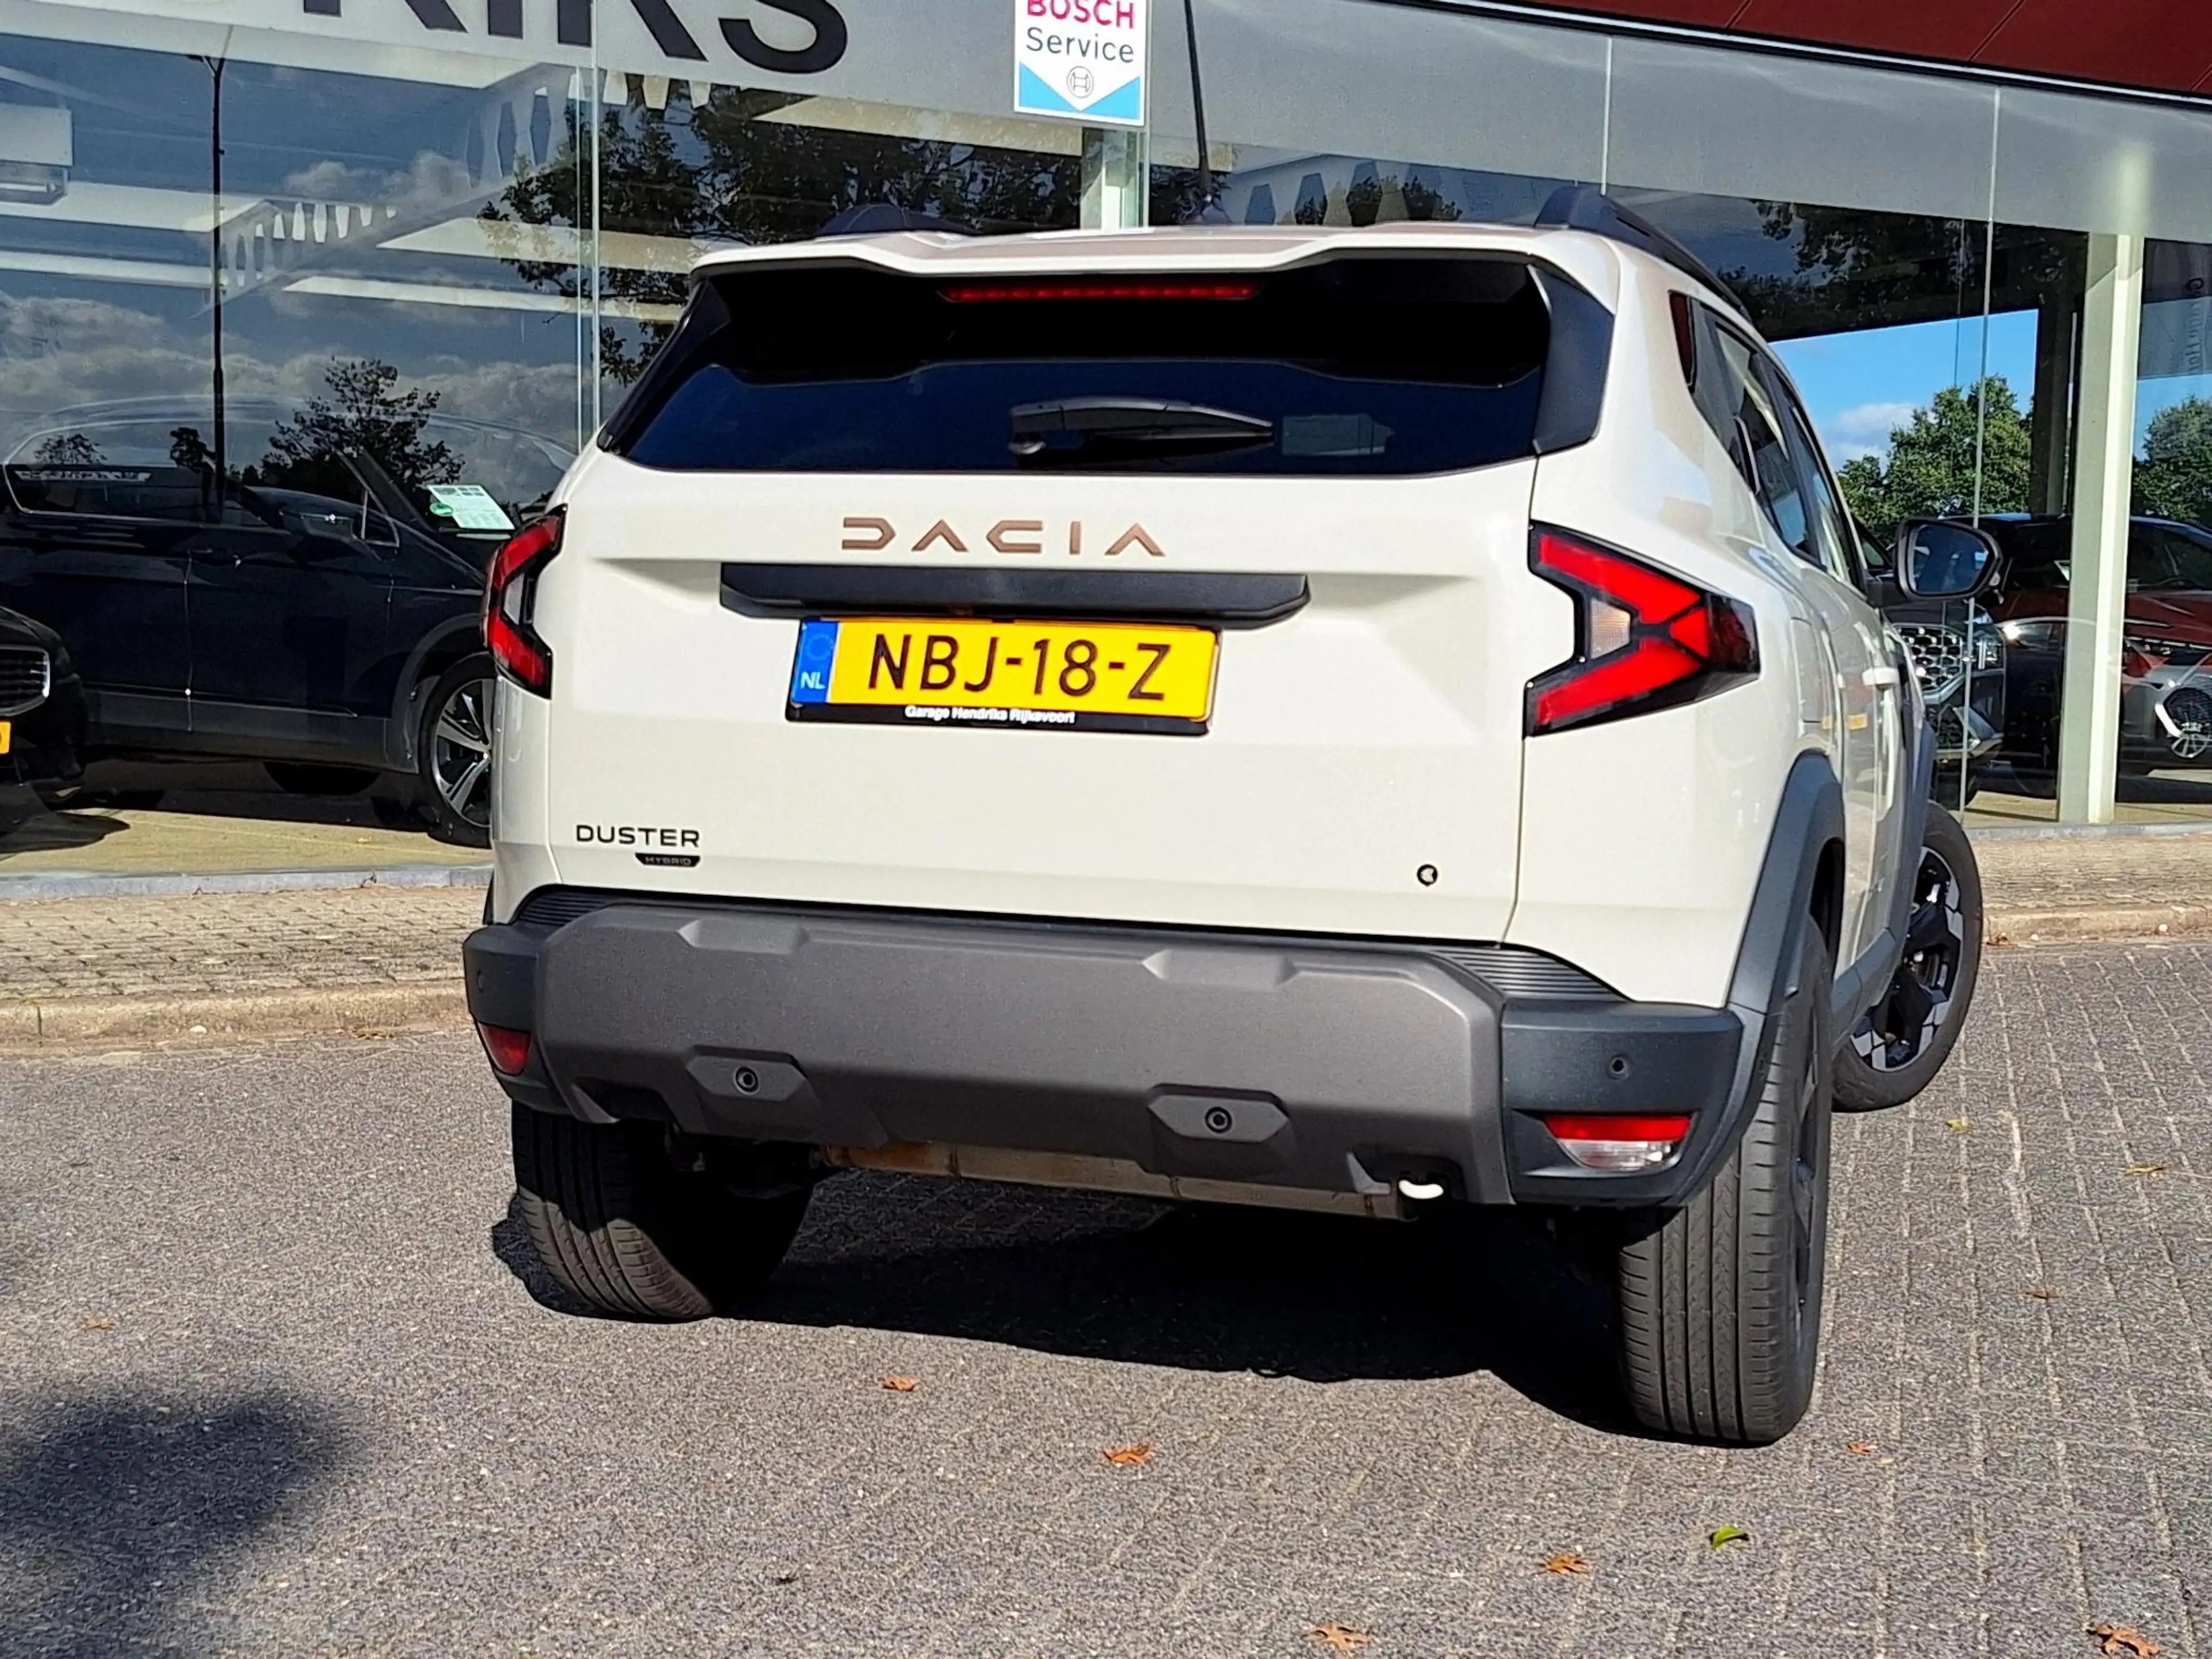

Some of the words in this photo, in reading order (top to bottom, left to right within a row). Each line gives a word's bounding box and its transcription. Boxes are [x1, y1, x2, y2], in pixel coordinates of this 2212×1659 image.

[1028, 0, 1134, 28] BOSCH
[1027, 27, 1134, 63] Service
[842, 517, 1165, 557] DACIA
[868, 634, 1171, 701] NBJ-18-Z
[800, 671, 825, 690] NL
[905, 705, 950, 721] Garage
[952, 706, 1007, 721] Hendriks
[576, 824, 699, 847] DUSTER
[645, 857, 691, 865] HYBRID
